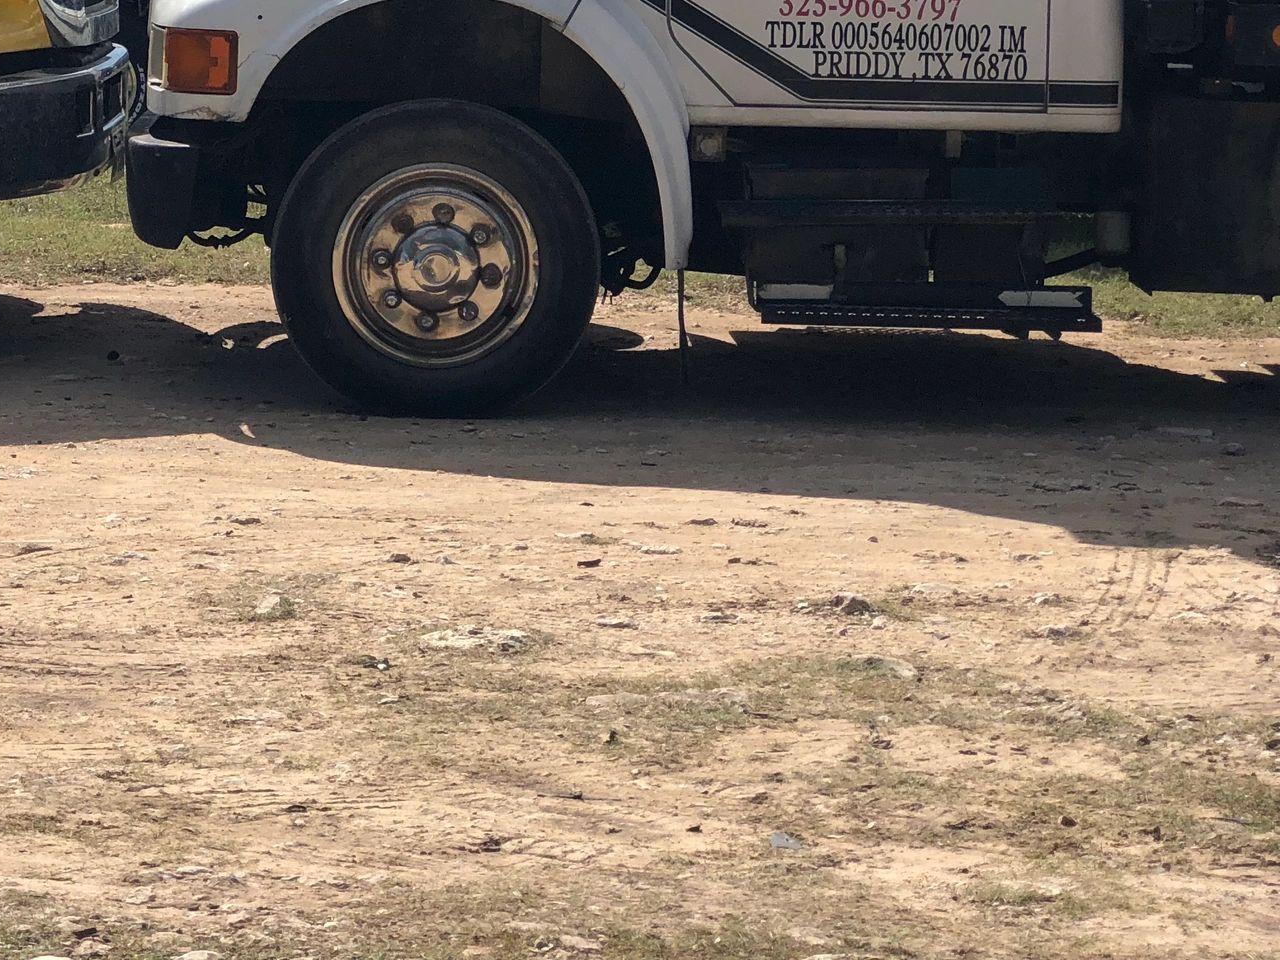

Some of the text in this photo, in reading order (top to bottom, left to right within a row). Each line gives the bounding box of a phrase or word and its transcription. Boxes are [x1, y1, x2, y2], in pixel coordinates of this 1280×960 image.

[765, 21, 1028, 54] TDLR 0005640607002 IM
[960, 53, 1028, 81] 76870
